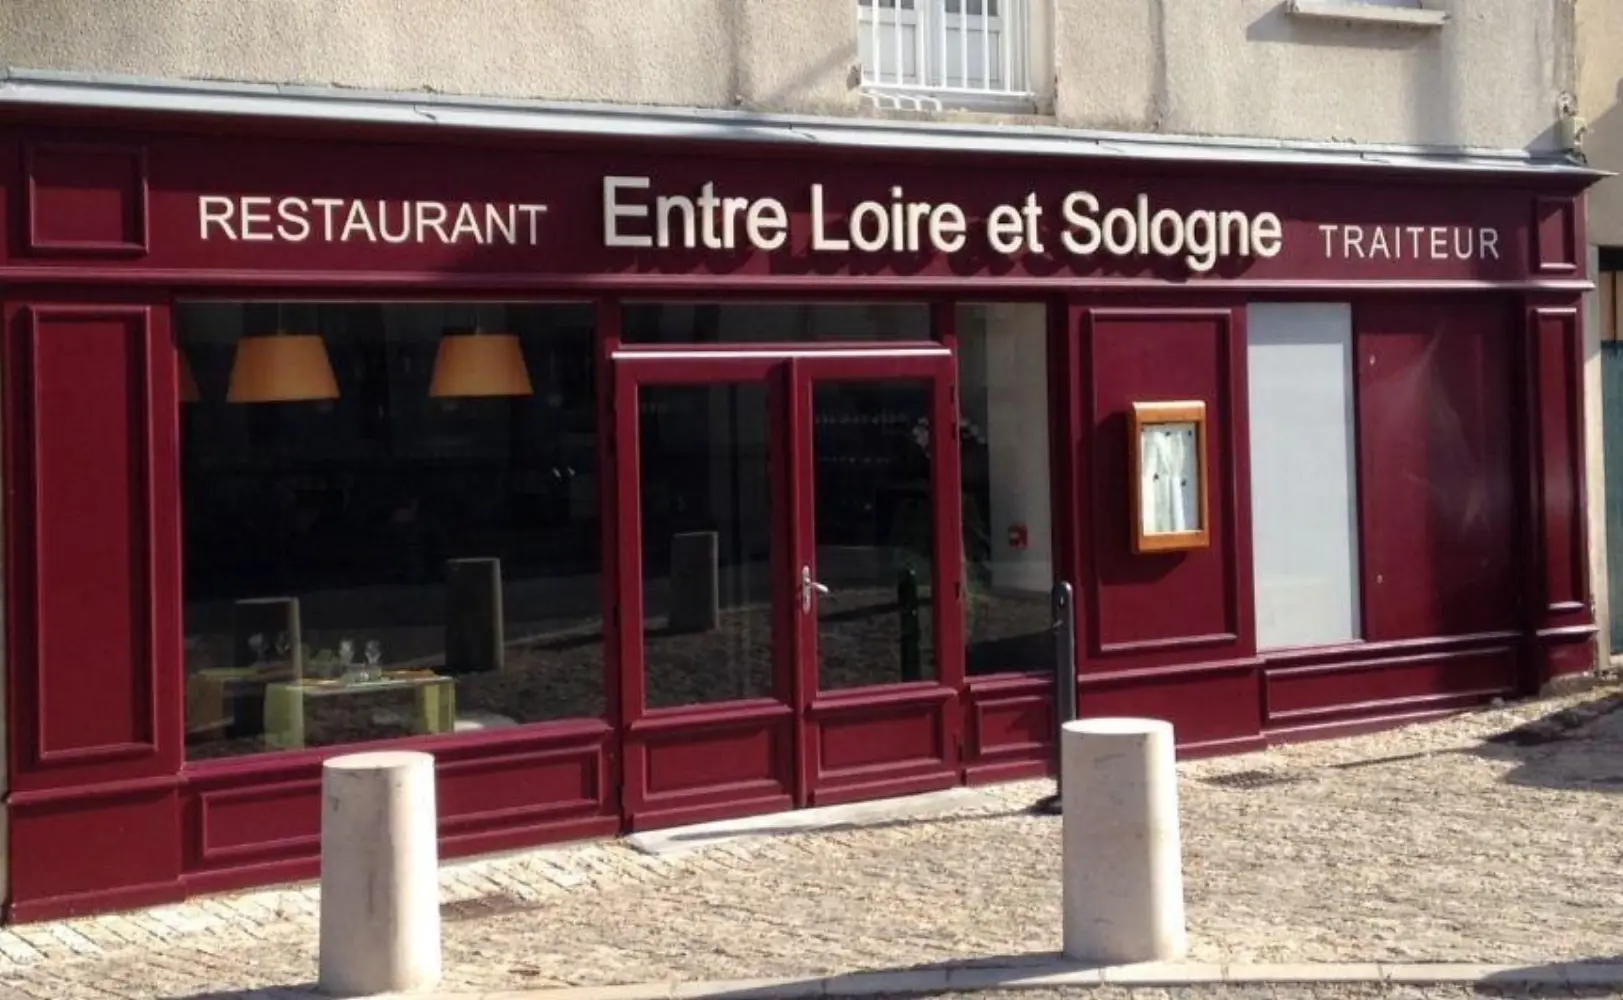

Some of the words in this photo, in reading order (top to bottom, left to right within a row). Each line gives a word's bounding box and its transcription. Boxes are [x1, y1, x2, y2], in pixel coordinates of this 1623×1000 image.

[198, 195, 548, 246] RESTAURANT
[603, 176, 788, 250] Entre
[811, 183, 967, 253] Loire
[986, 192, 1045, 255] et
[1061, 191, 1283, 272] Sologne
[1318, 224, 1501, 260] TRAITEUR
